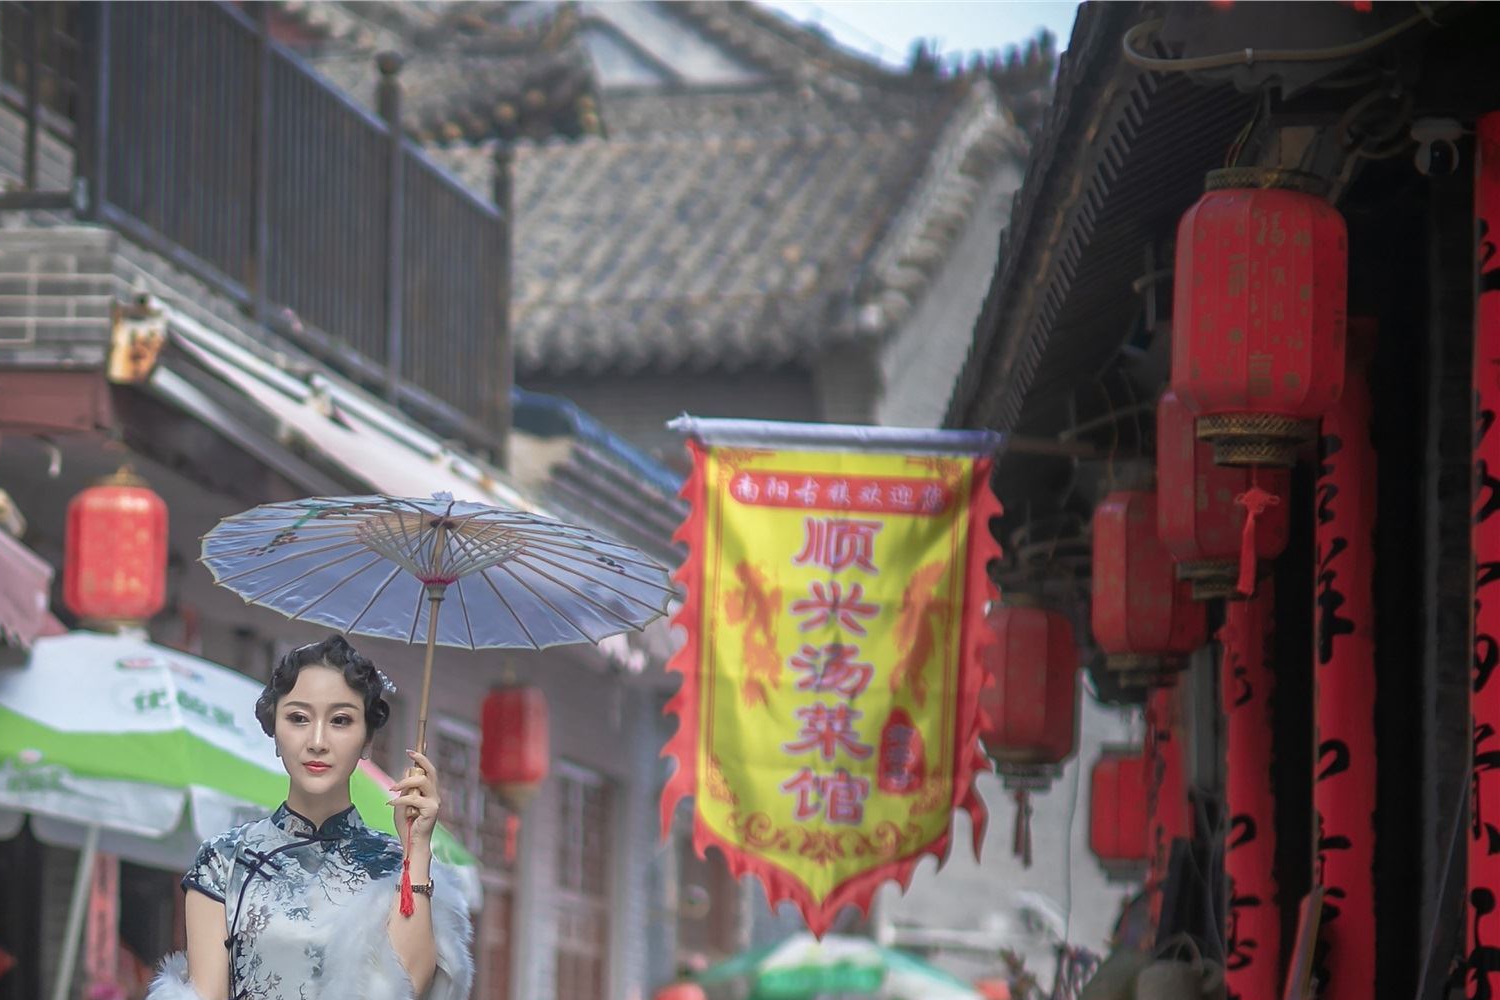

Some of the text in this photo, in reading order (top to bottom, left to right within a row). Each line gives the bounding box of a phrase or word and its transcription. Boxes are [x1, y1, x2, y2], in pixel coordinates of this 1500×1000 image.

[780, 516, 883, 826] 顺兴汤菜馆
